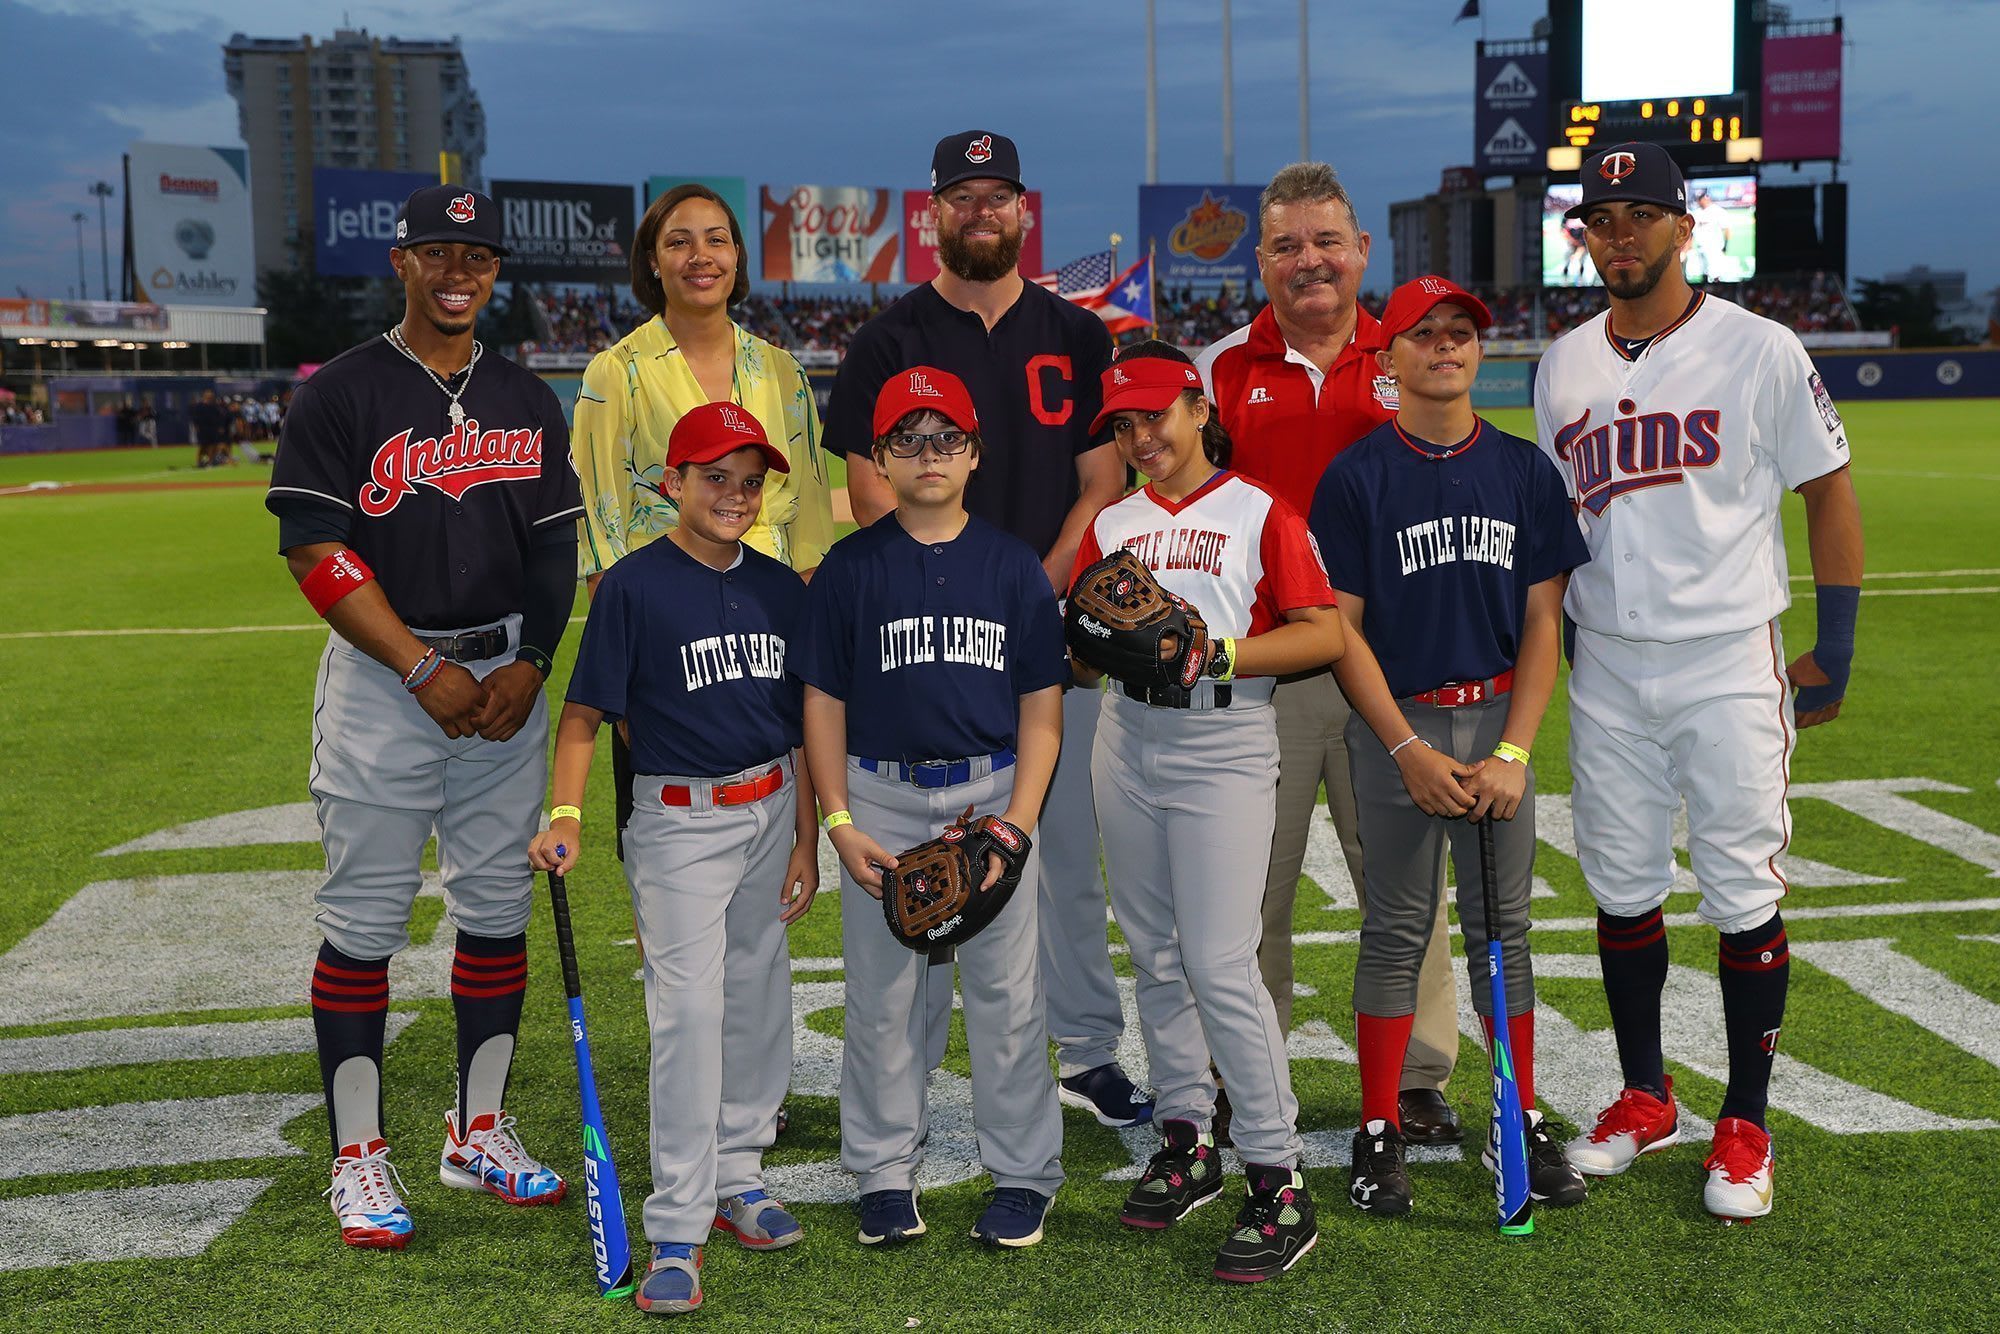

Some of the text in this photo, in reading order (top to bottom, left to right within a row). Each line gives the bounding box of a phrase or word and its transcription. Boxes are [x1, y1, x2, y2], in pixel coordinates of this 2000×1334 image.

[326, 198, 402, 246] jetB
[795, 237, 863, 259] LIGHT
[177, 269, 238, 295] Ashley
[910, 372, 939, 396] LL
[1025, 355, 1074, 425] C
[1248, 396, 1274, 404] RUSSELL
[1554, 398, 1721, 508] Twins
[1166, 529, 1227, 577] LEAGUE
[1396, 516, 1516, 576] LITTLE LEAGUE
[331, 565, 345, 580] 12
[880, 616, 1007, 673] LITTLE LEAGUE
[1078, 614, 1112, 639] Rawlings
[680, 634, 743, 692] LITTLE
[927, 914, 964, 941] Rawlings
[1493, 1074, 1507, 1220] EASTON
[585, 1156, 611, 1285] EASTON
